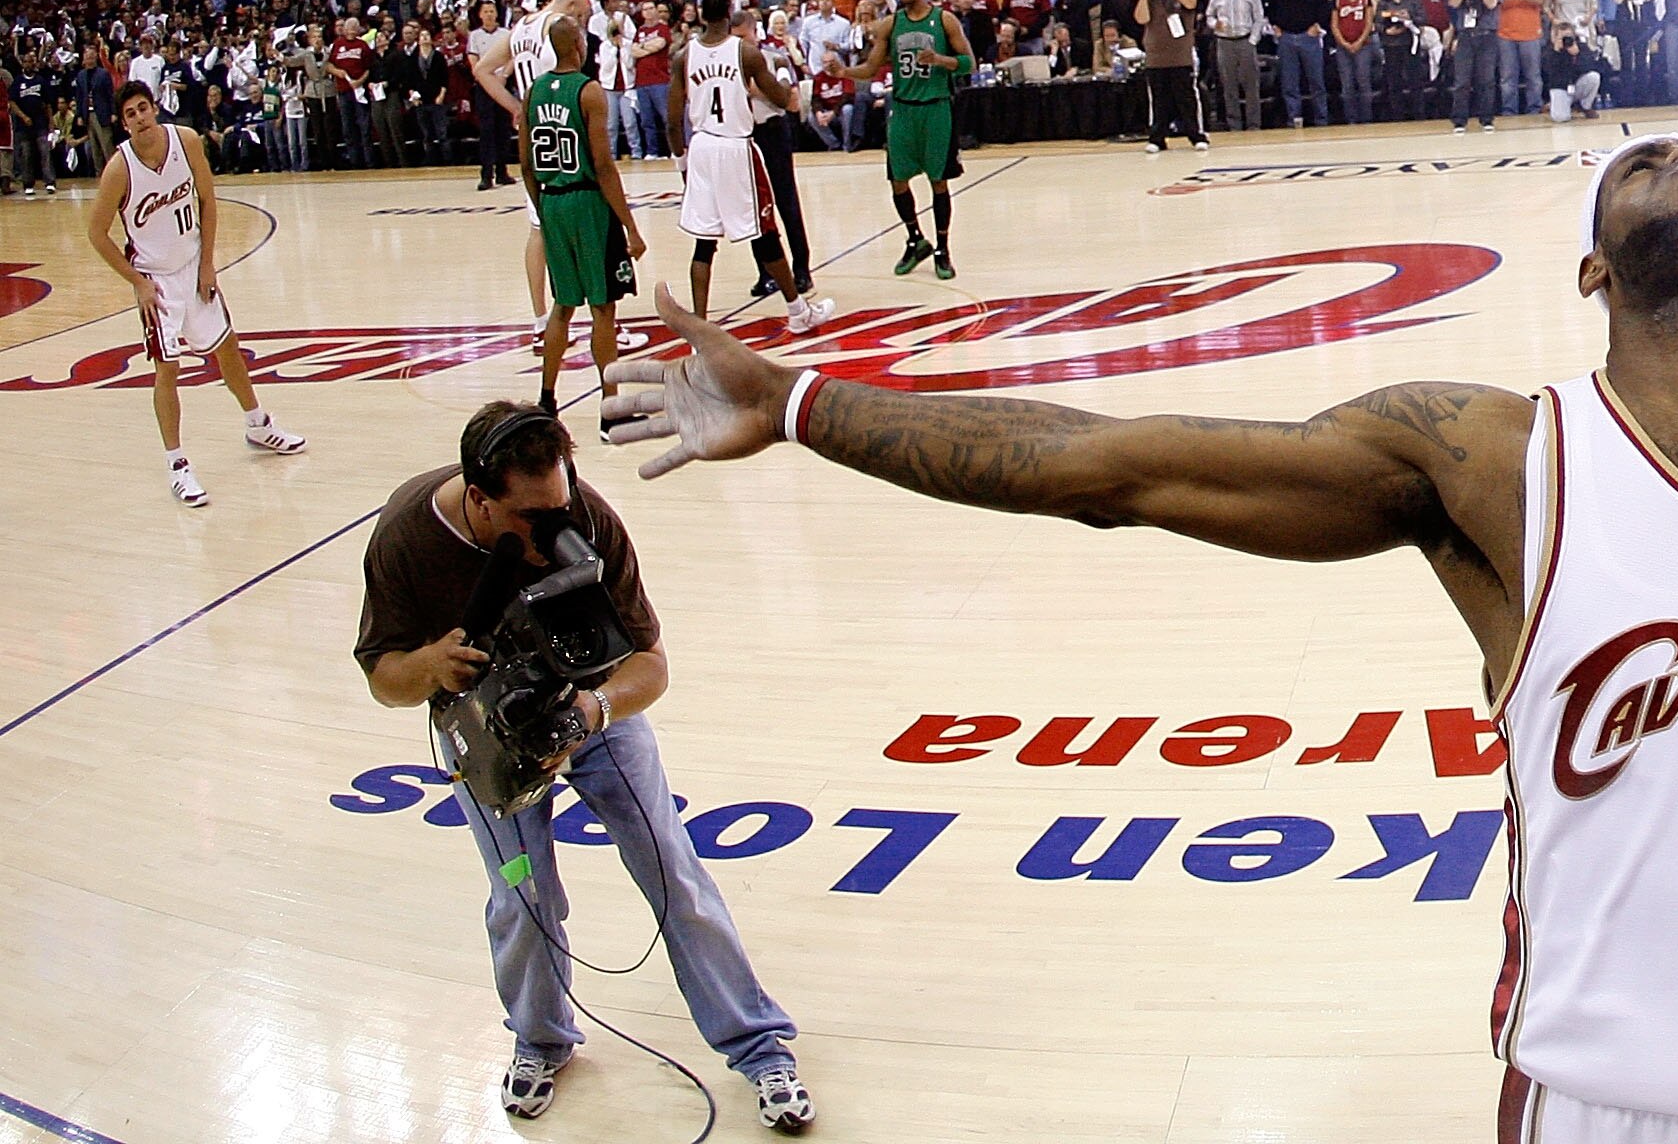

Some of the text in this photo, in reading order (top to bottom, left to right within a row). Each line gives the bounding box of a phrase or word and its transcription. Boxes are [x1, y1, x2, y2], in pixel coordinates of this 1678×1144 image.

[517, 59, 536, 93] 11
[689, 63, 739, 87] WALLACE
[536, 103, 571, 127] ALLEN
[711, 86, 725, 124] 4
[531, 125, 580, 175] 20
[174, 204, 193, 236] 10
